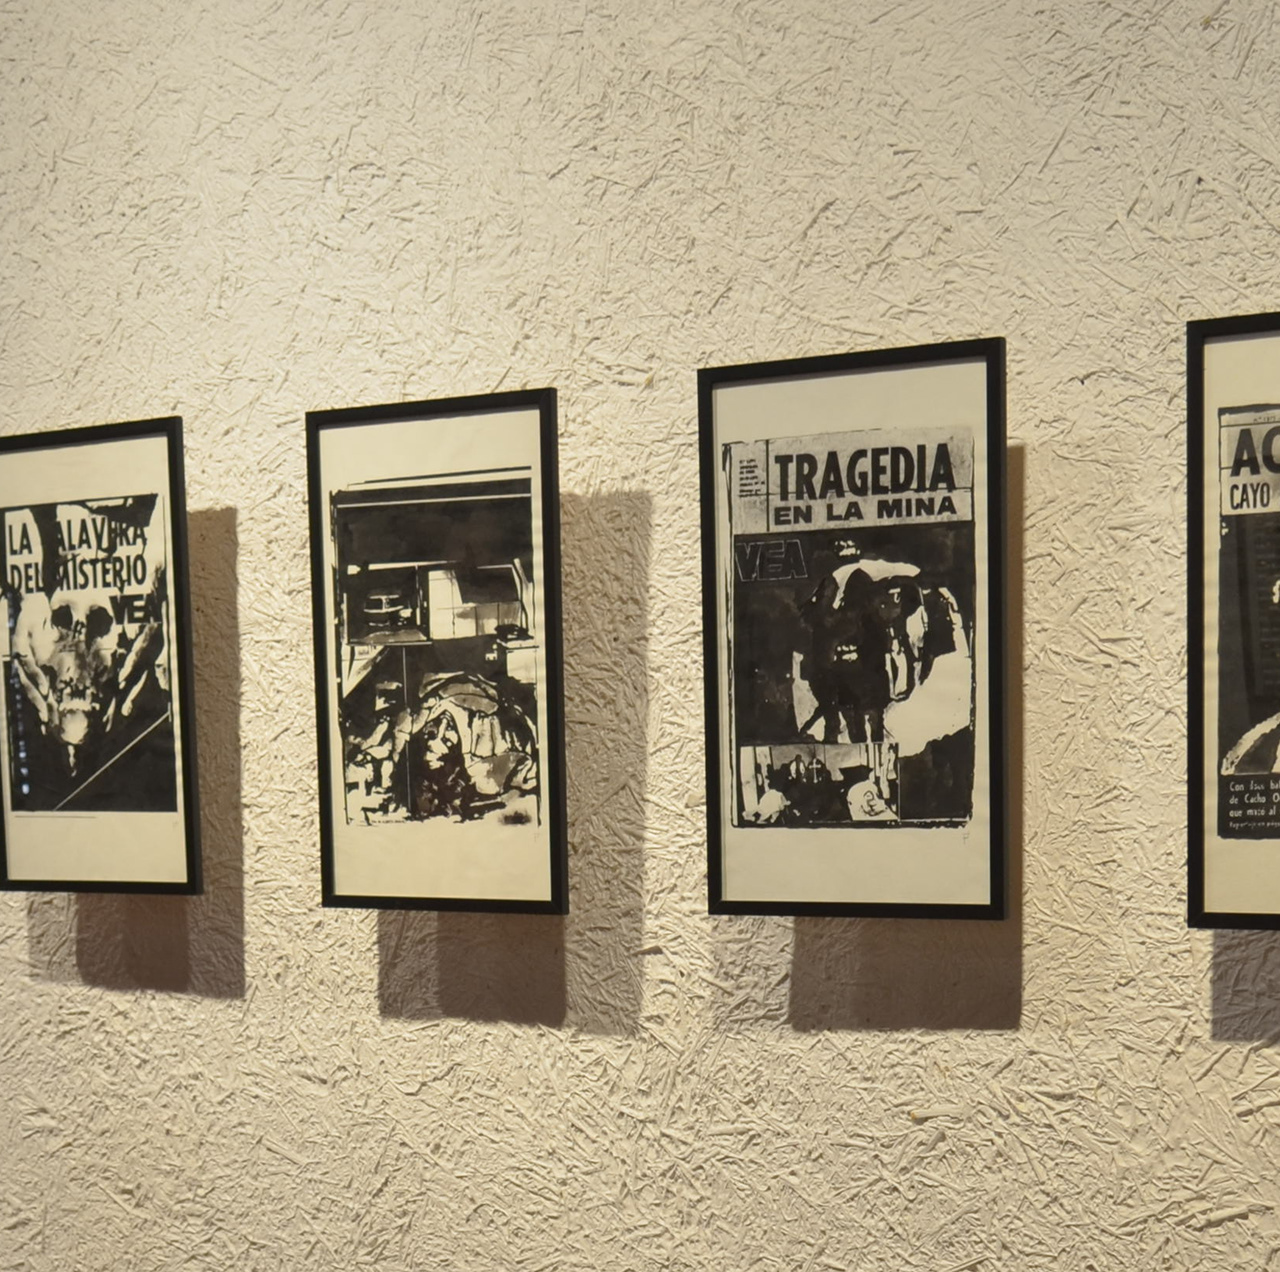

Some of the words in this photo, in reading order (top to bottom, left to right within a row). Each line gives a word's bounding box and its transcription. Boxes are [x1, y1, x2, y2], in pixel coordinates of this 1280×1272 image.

[774, 443, 956, 501] TRAGEDIA
[774, 505, 813, 526] EN
[826, 501, 864, 521] LA
[877, 496, 958, 519] MINA
[1230, 482, 1270, 510] CAYO
[9, 523, 33, 556] LA
[11, 562, 44, 595] DEL
[56, 554, 148, 592] MISTERIO
[735, 539, 808, 582] VEA
[109, 593, 164, 625] VEA
[1229, 781, 1245, 792] Con
[1229, 795, 1238, 805] de
[1244, 793, 1266, 804] Cacho
[1229, 809, 1242, 818] que
[1268, 806, 1276, 816] al
